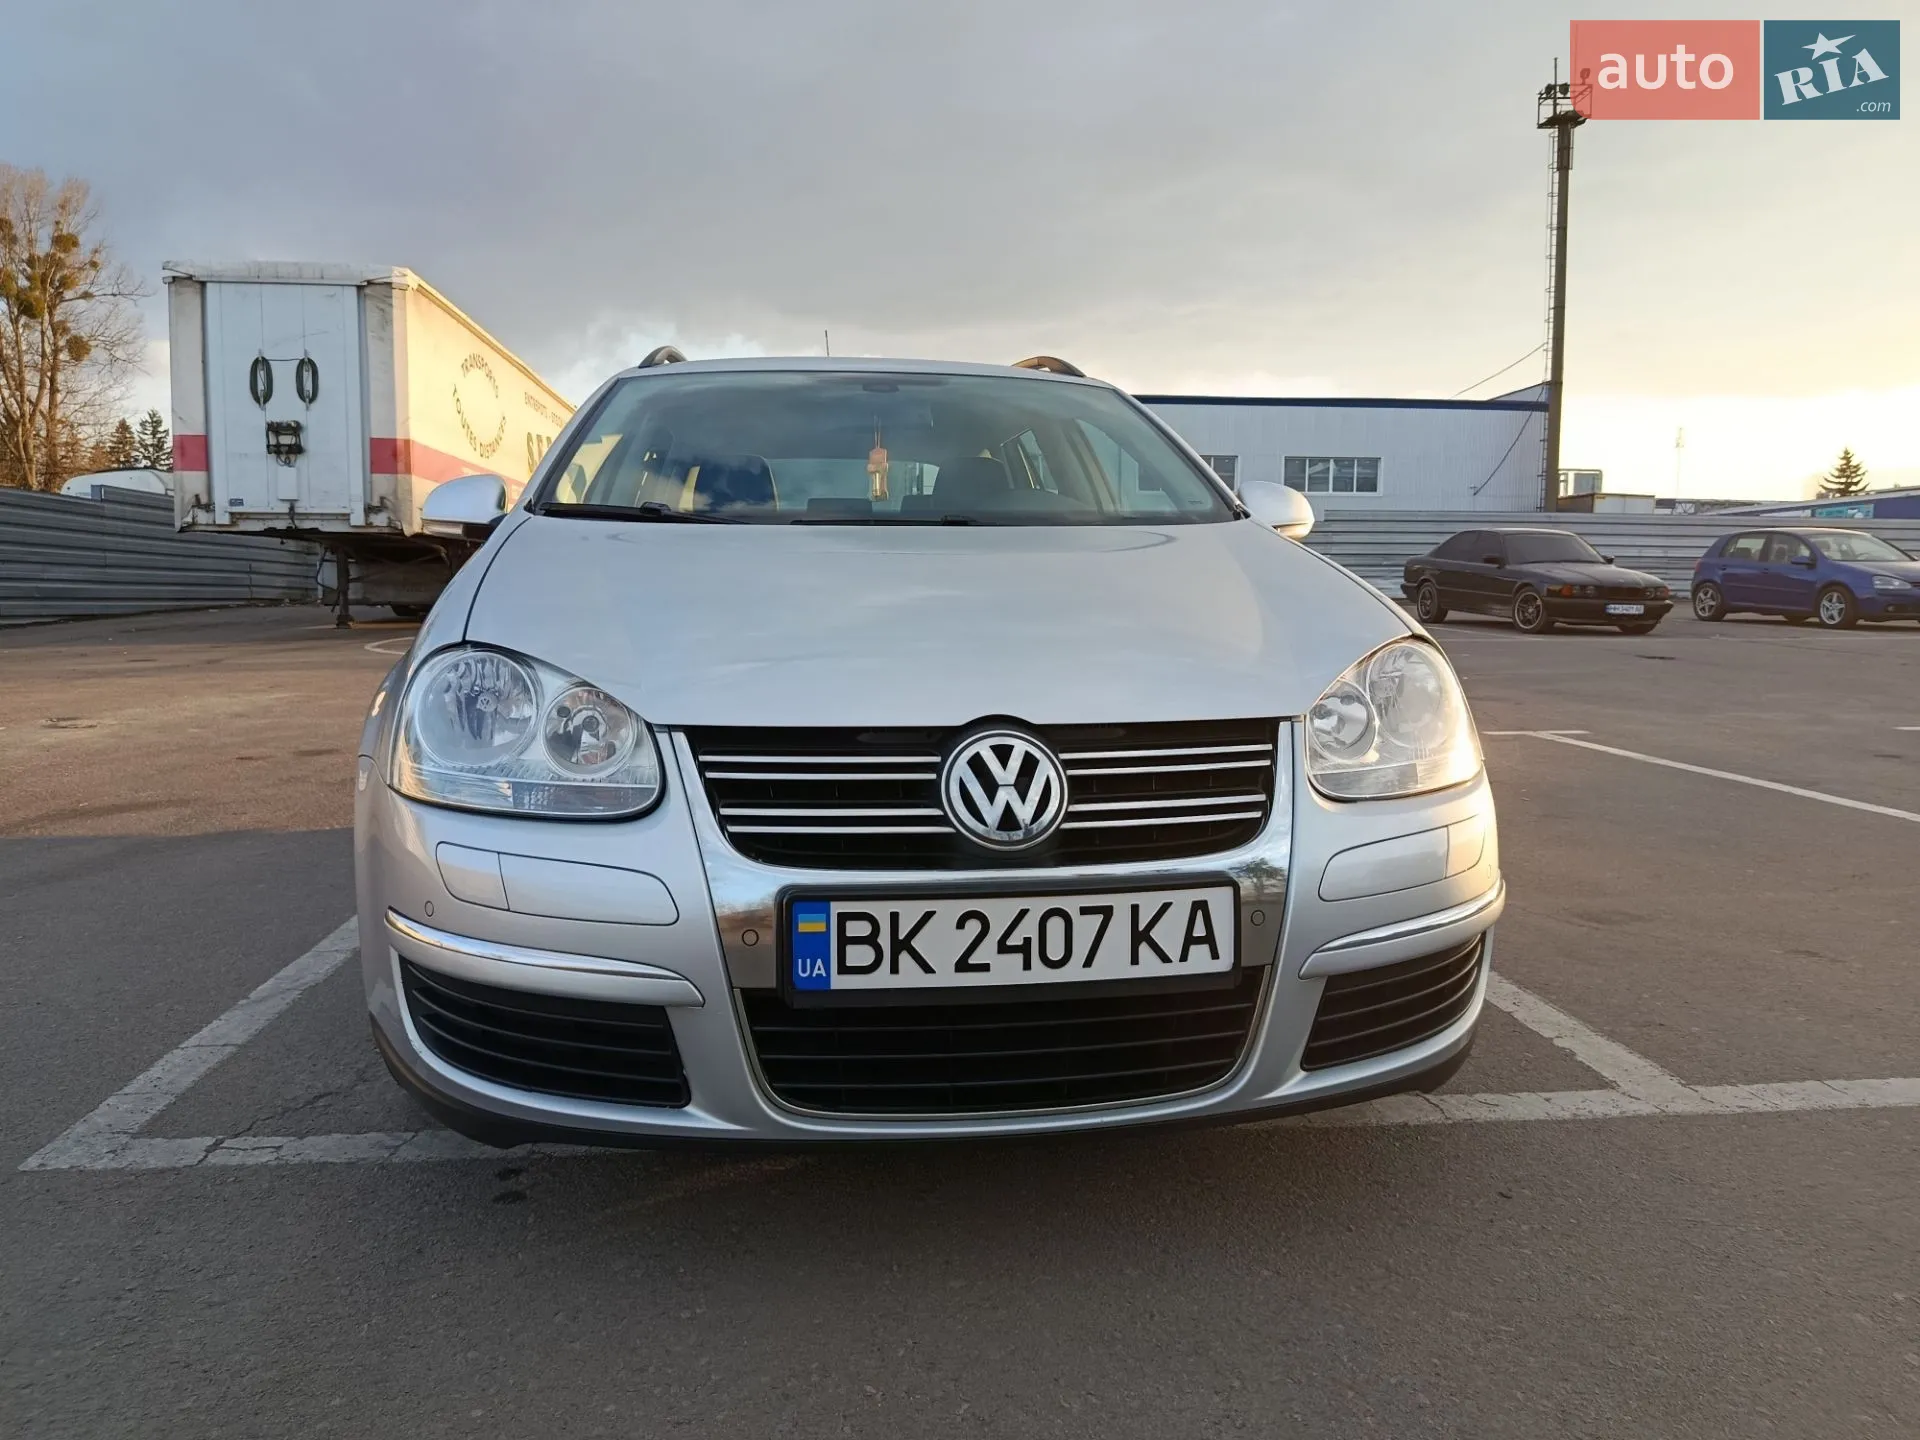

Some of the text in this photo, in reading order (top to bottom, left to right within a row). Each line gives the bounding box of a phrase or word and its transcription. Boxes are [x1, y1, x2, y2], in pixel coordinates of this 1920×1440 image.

[836, 899, 1221, 976] BK 2407 KA
[797, 958, 827, 978] UA
